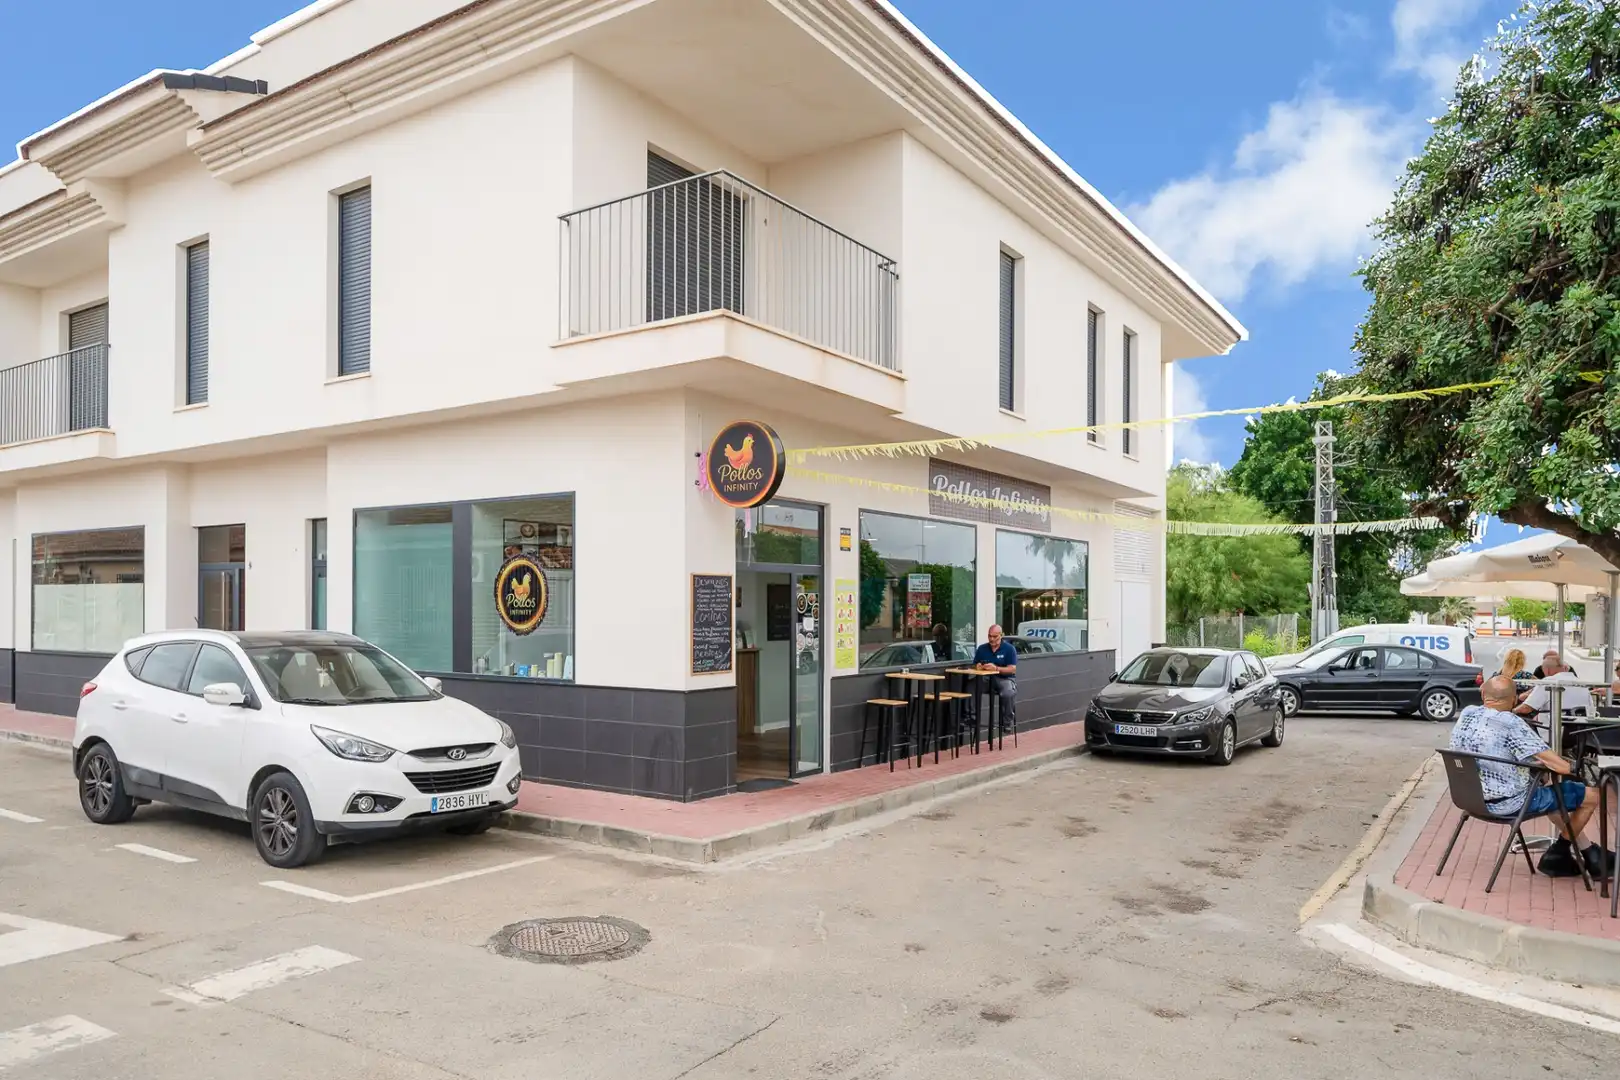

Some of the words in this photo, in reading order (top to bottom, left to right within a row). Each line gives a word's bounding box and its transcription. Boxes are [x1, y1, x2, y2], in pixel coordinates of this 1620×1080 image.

[717, 462, 764, 483] Pollos
[723, 482, 759, 492] INFINITY
[506, 593, 536, 608] Pollos
[1400, 636, 1450, 650] OTIS
[1120, 725, 1138, 734] 2520
[1140, 727, 1155, 736] LHR
[438, 796, 465, 810] 2836
[468, 793, 487, 806] HYL
